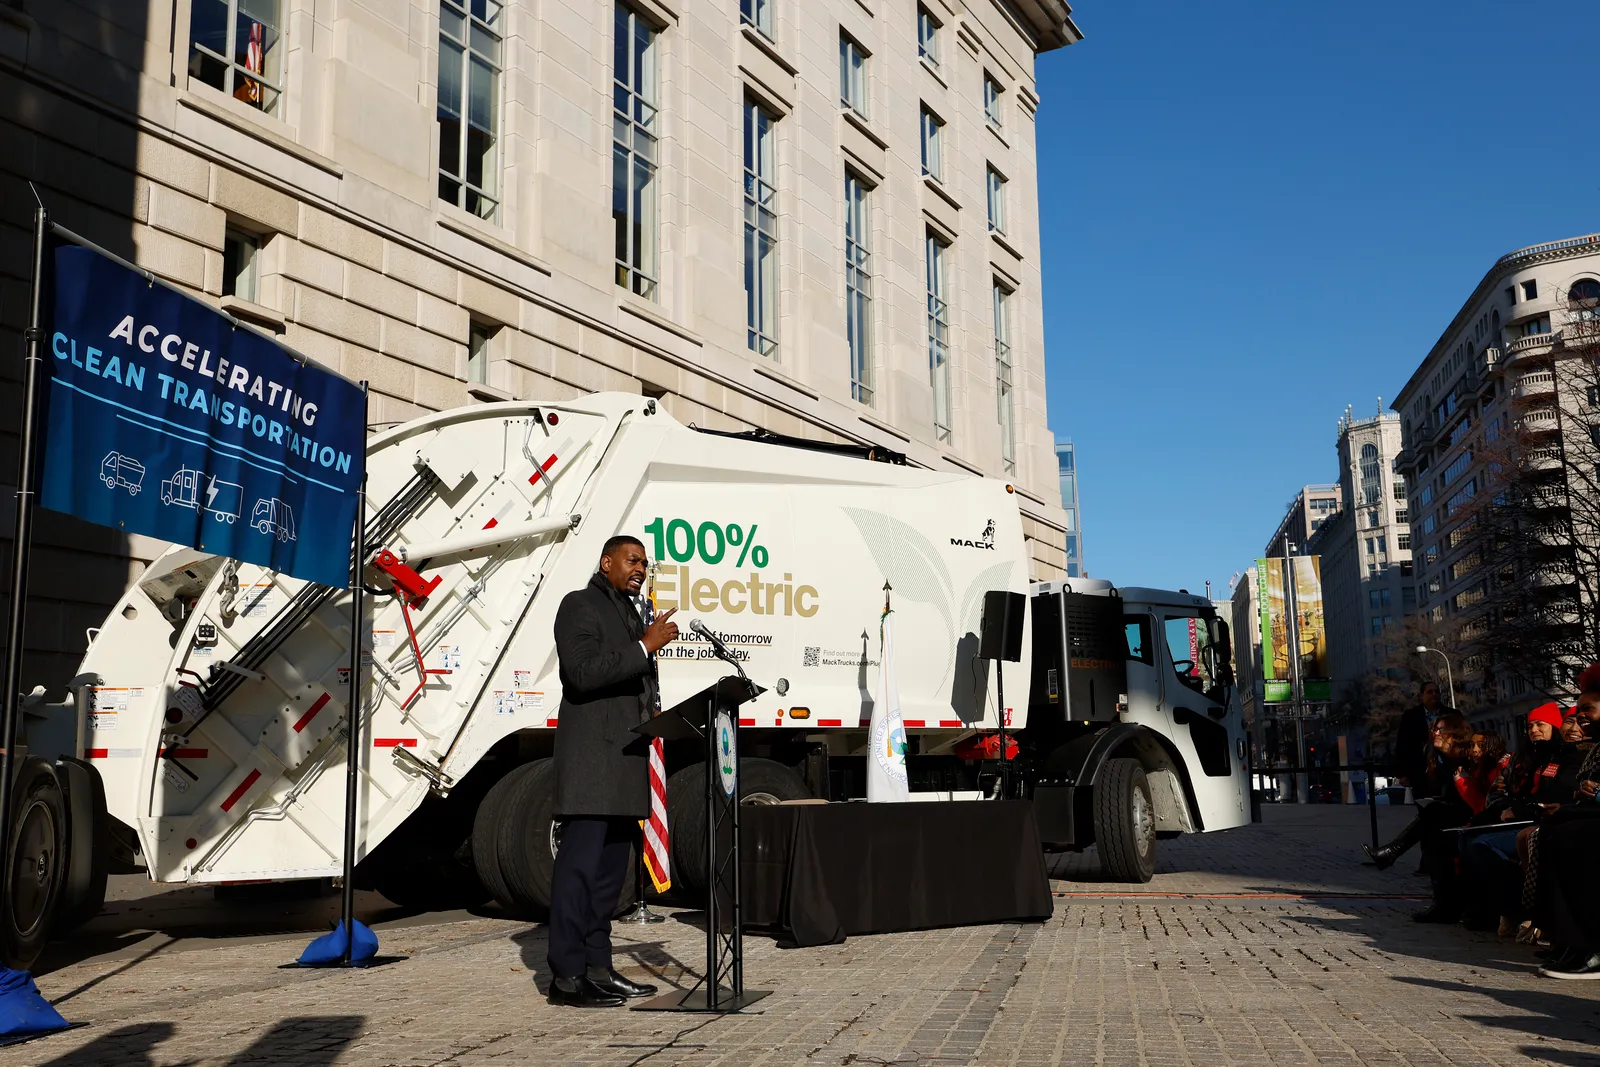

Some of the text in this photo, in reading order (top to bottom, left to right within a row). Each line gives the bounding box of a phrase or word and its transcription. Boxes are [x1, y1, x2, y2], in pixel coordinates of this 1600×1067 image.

[108, 315, 318, 426] ACCELERATING
[52, 332, 351, 474] CLEAN TRANSPORTATION
[644, 517, 769, 568] 100%
[950, 538, 995, 550] MACK
[647, 564, 819, 617] Electric
[1259, 565, 1268, 614] FOOD COURT
[658, 648, 673, 658] on
[676, 646, 695, 658] the
[696, 647, 715, 660] job
[675, 631, 702, 642] ruck
[719, 631, 773, 644] tomorrow
[1070, 659, 1121, 669] ELECTRI
